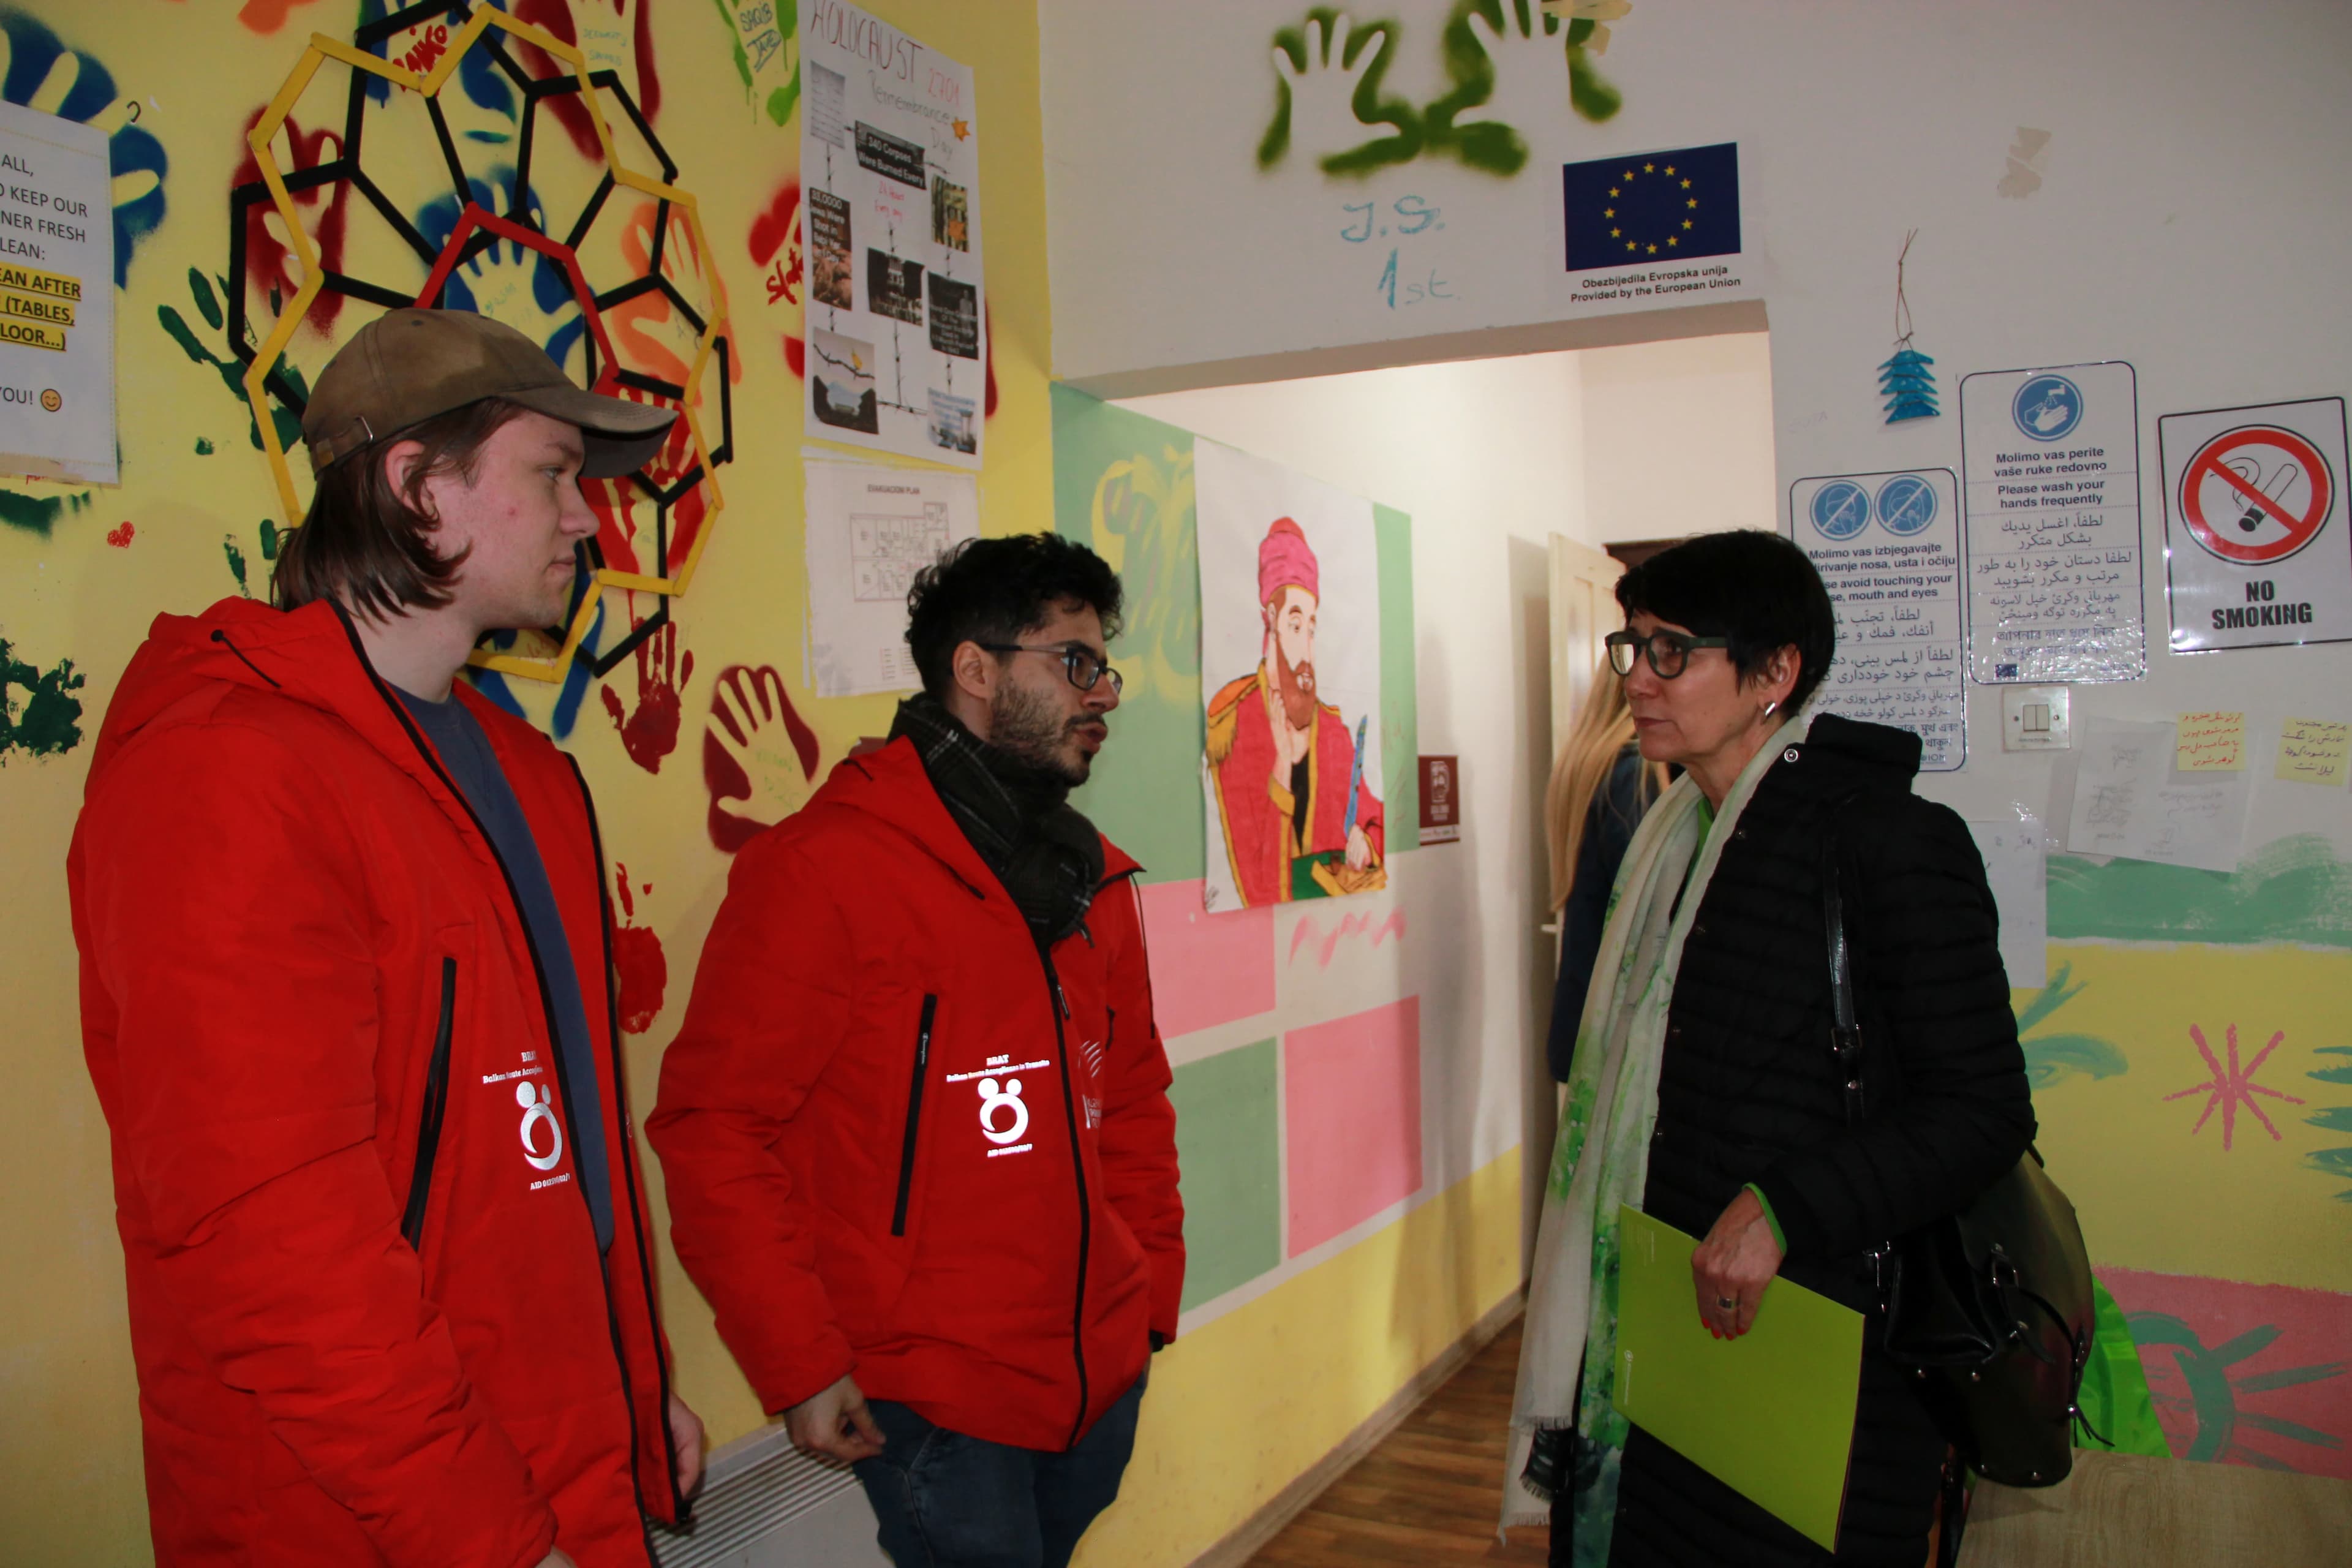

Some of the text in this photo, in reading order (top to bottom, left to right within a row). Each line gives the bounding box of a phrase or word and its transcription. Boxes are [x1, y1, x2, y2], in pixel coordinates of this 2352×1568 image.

[811, 0, 922, 83] HOLOCAUST
[2, 154, 34, 177] ALL,
[10, 186, 48, 206] KEEP
[54, 197, 88, 217] OUR
[39, 219, 86, 243] FRESH
[0, 268, 81, 298] AN AFTER
[1582, 266, 1728, 288] Obezbijedila Evropska unija
[1570, 277, 1741, 302] Provided by the European Union
[6, 296, 75, 326] (TABLES,
[0, 386, 32, 405] OU!
[1996, 452, 2040, 464] Molimo
[2069, 447, 2104, 460] perite
[1994, 461, 2107, 477] vaše ruke redovno
[1998, 480, 2105, 496] Please wash your
[2000, 493, 2103, 508] hands frequently
[2001, 520, 2031, 534] يديك
[2036, 517, 2068, 532] اغسل
[2019, 532, 2092, 550] بشكل متكرر
[1809, 543, 1942, 560] Molimo vas izbjegavajte
[1861, 561, 1891, 570] nosa,
[1928, 555, 1956, 567] očiju
[1977, 559, 2000, 573] طور
[2005, 562, 2016, 573] به
[2021, 558, 2030, 571] را
[2035, 558, 2059, 567] خود
[2064, 554, 2101, 568] دستان
[1840, 578, 1871, 589] avoid
[1874, 576, 1923, 587] touching
[1926, 575, 1952, 586] your
[2075, 575, 2081, 584] و
[2087, 570, 2119, 582] مرتب
[1830, 589, 1938, 602] se, mouth and eyes
[2245, 579, 2275, 603] NO
[2212, 601, 2312, 630] SMOKING
[1857, 631, 1863, 641] و
[1869, 626, 1895, 638] فمك
[1885, 650, 1908, 666] لمس
[1913, 650, 1922, 664] از
[1928, 646, 1953, 661] لطفاً
[1895, 668, 1918, 681] خود
[1924, 666, 1954, 683] چشم
